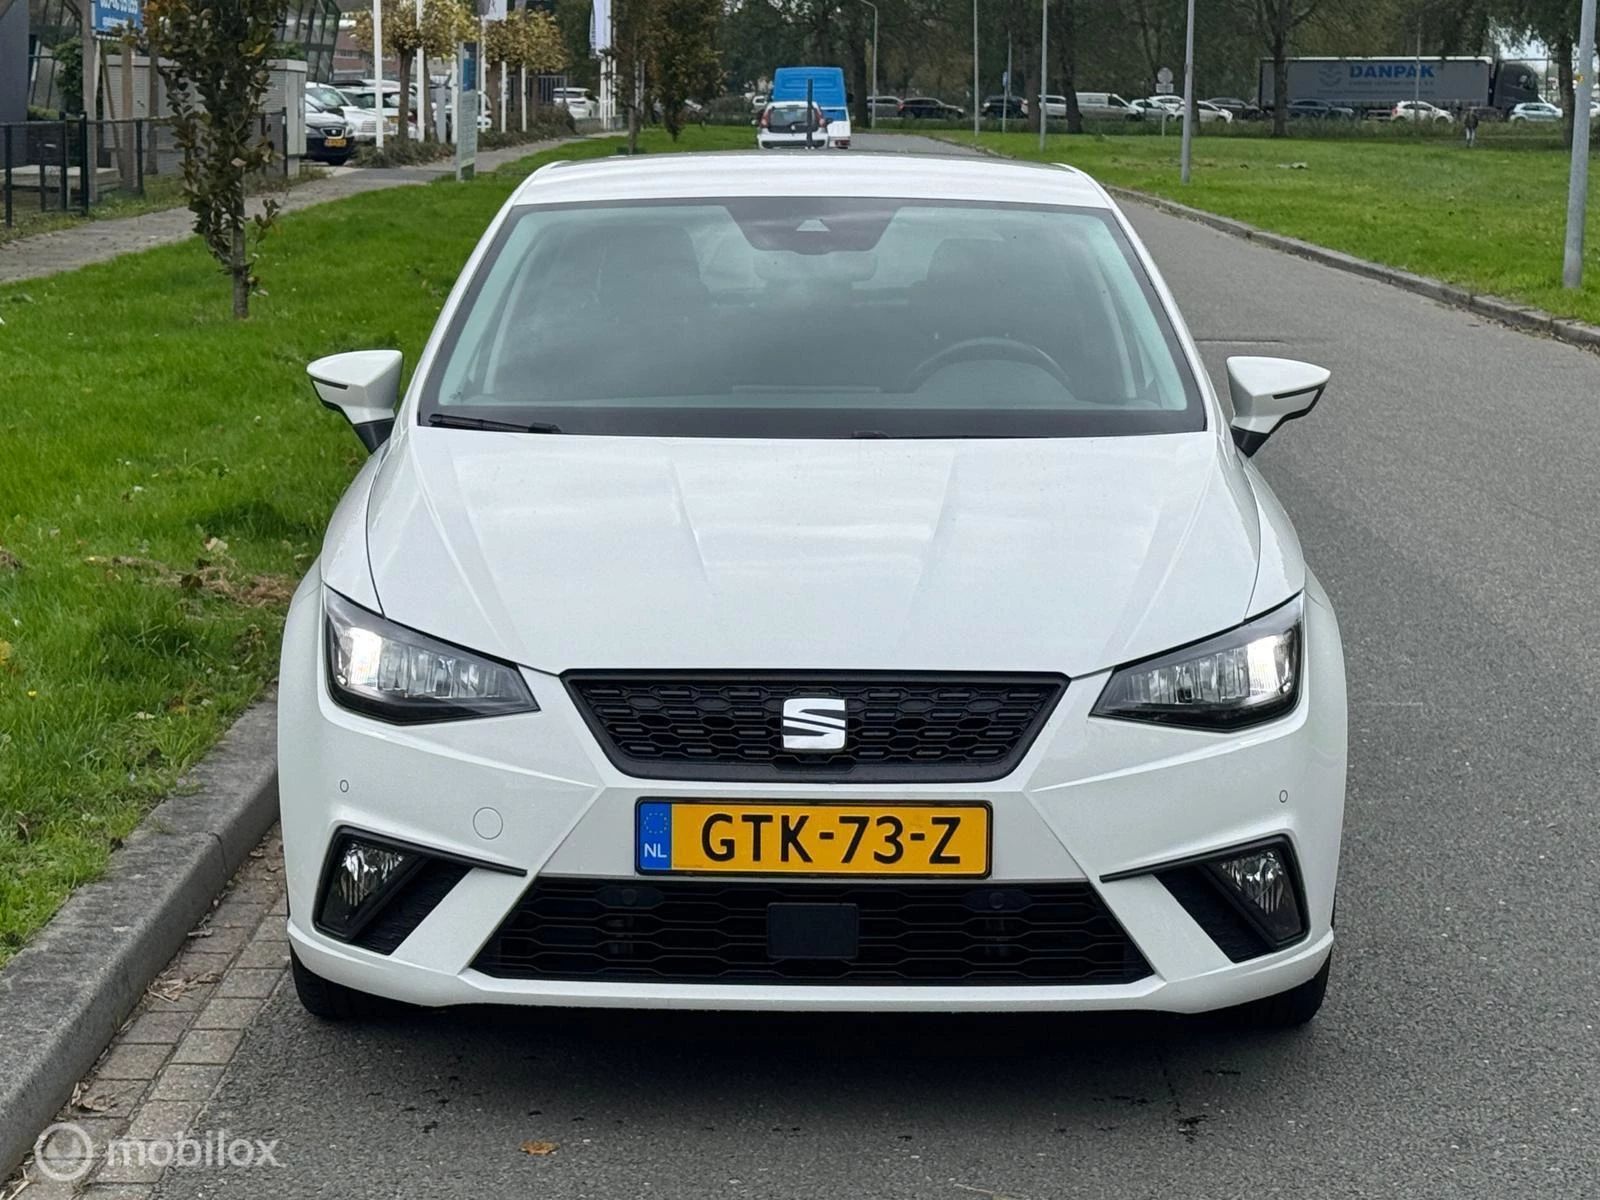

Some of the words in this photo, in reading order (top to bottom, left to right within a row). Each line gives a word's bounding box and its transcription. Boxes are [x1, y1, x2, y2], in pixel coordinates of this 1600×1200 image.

[1350, 64, 1435, 78] DANPAK
[701, 813, 961, 864] GTK-73-Z
[644, 843, 667, 858] NL
